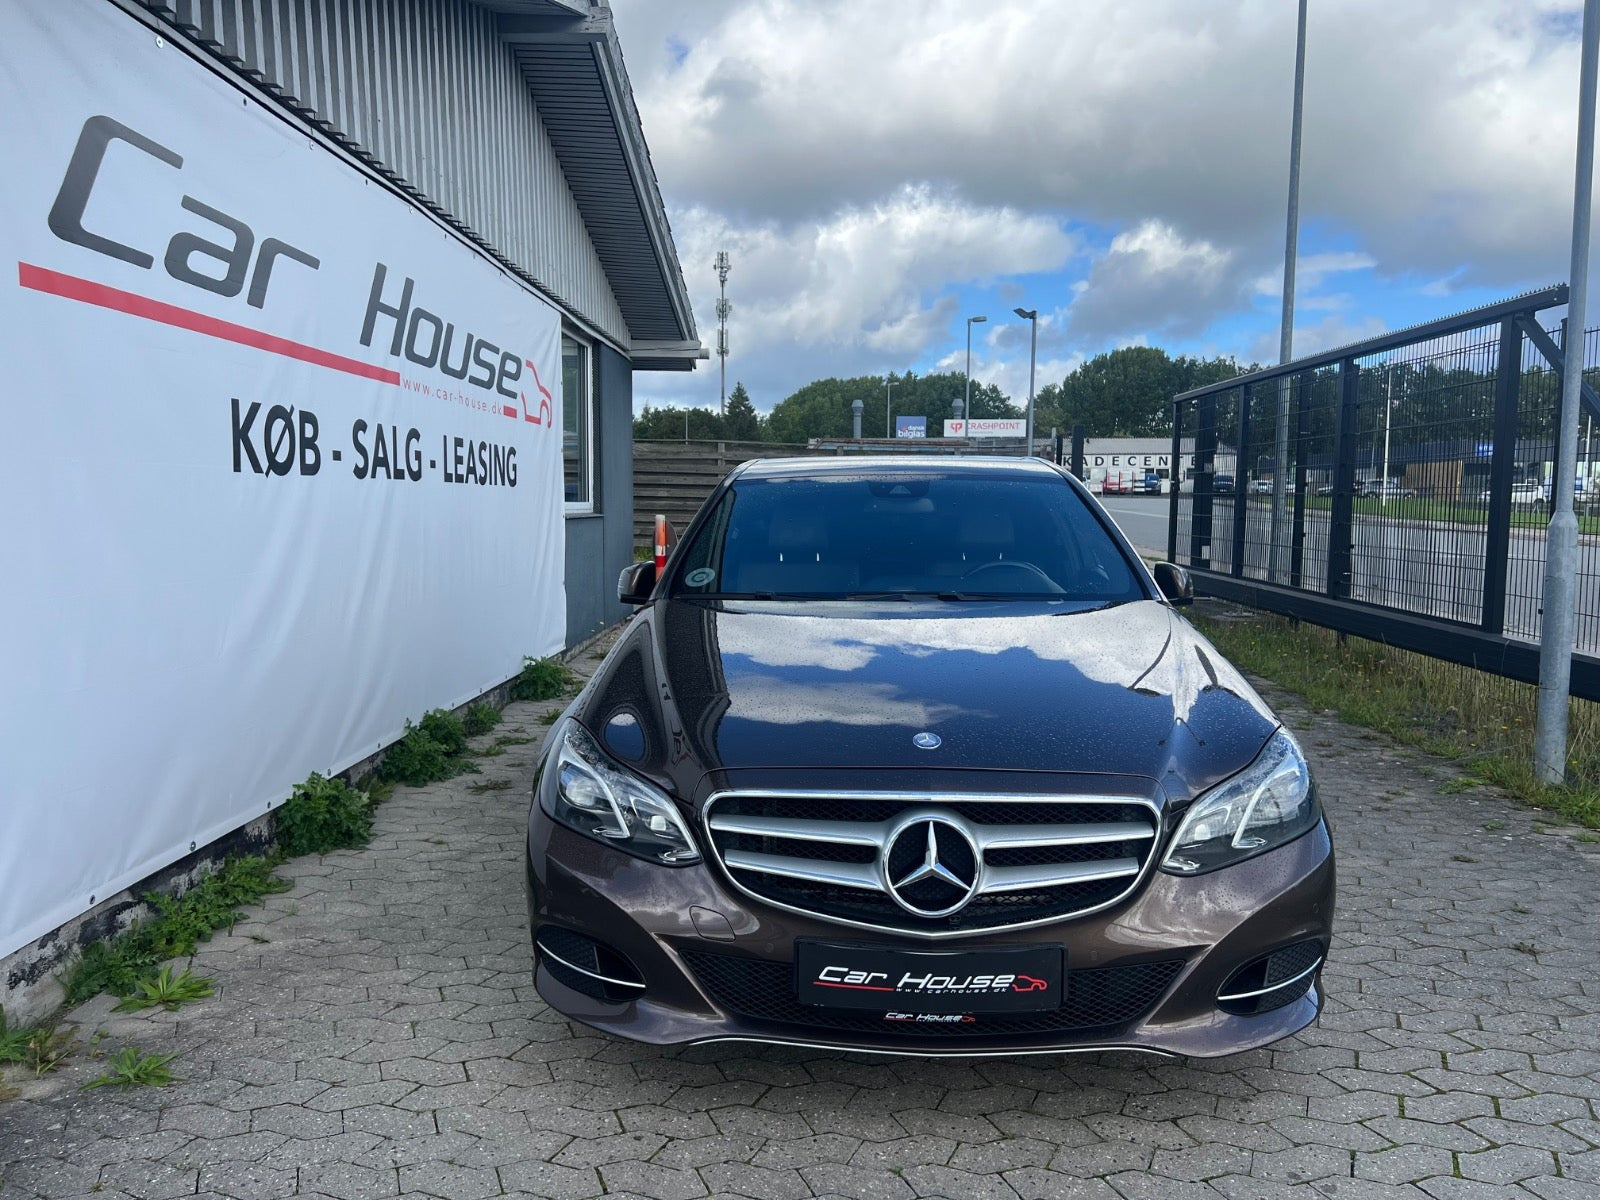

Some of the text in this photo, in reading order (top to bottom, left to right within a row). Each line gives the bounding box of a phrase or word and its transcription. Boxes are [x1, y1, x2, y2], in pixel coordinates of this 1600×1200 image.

[48, 115, 523, 400] Car House
[402, 378, 503, 416] www.car-house.dk
[967, 422, 1021, 430] CRASHPOINT
[231, 397, 321, 478] KØB
[352, 418, 422, 481] SALG
[443, 434, 518, 488] LEASING
[818, 966, 1016, 990] Car House
[915, 1013, 963, 1021] House
